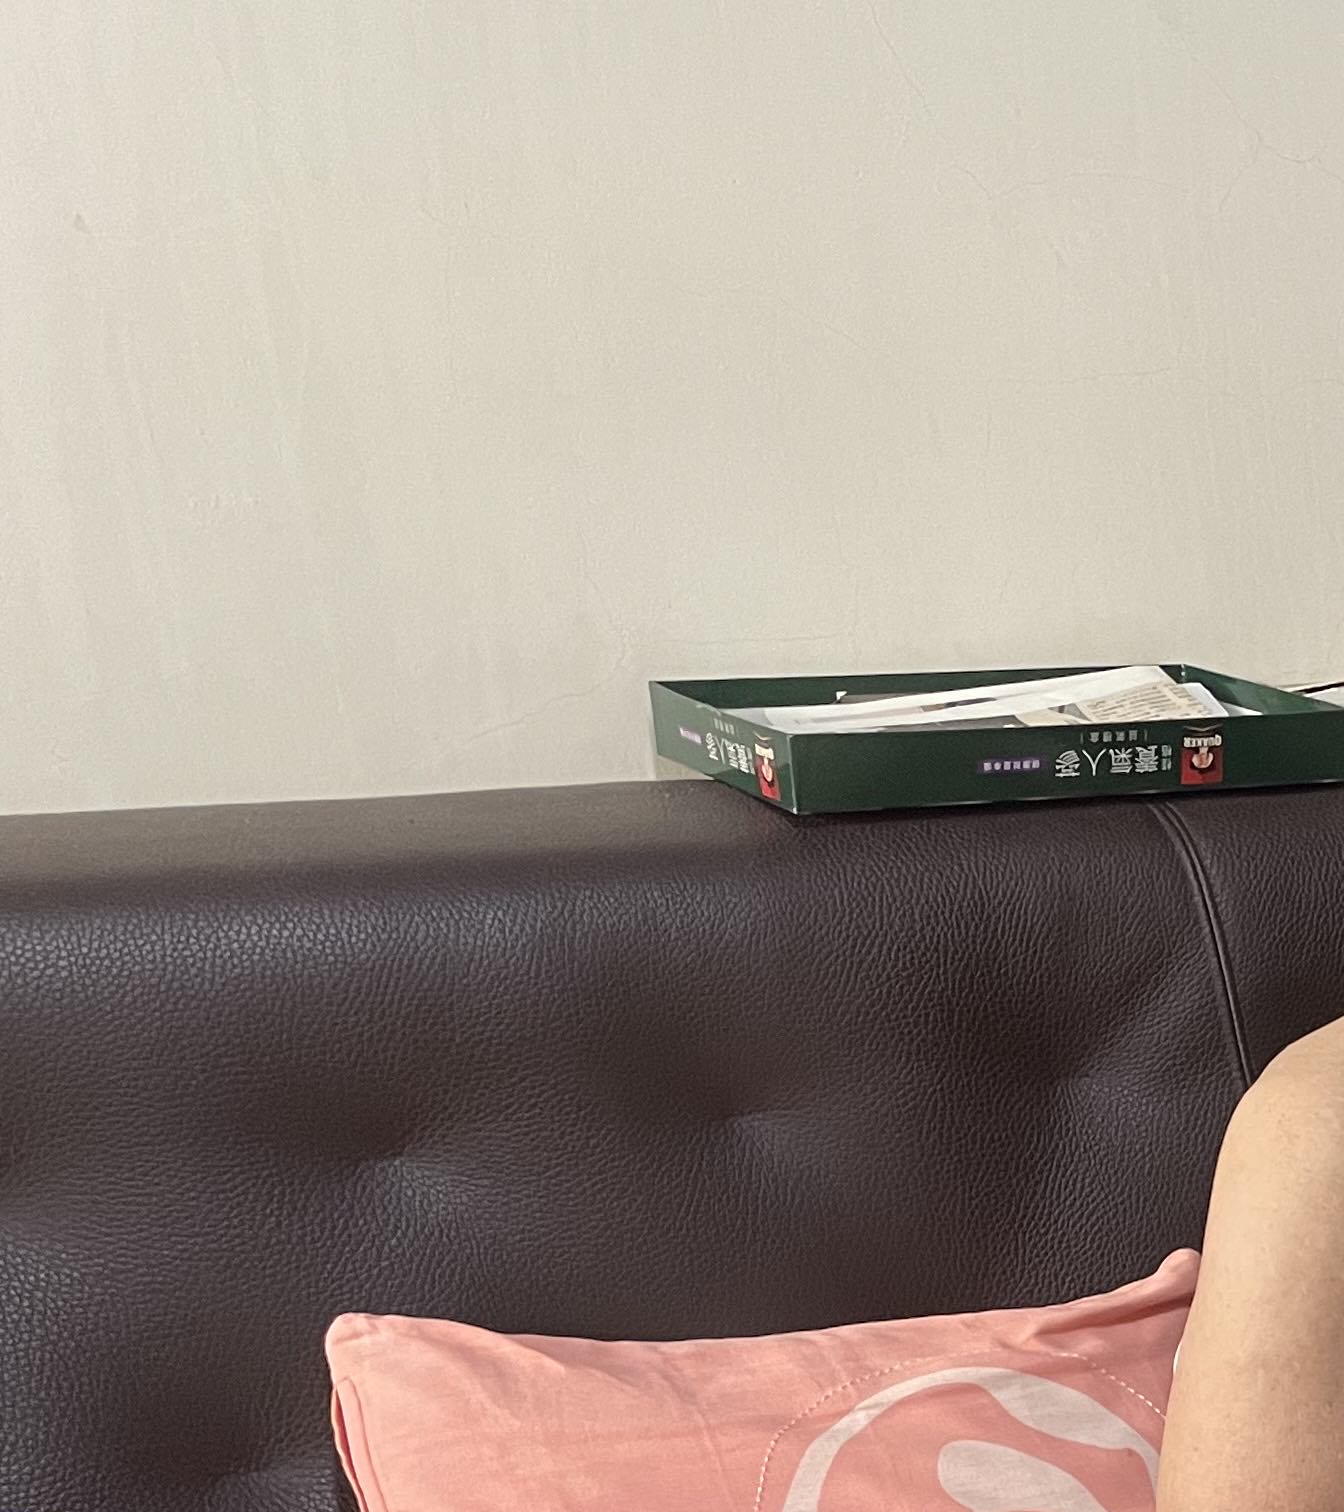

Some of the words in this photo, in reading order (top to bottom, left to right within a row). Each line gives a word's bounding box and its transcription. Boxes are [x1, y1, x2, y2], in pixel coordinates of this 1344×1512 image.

[1183, 735, 1222, 748] QUAKER
[1053, 745, 1159, 778] 養氣人蔘
